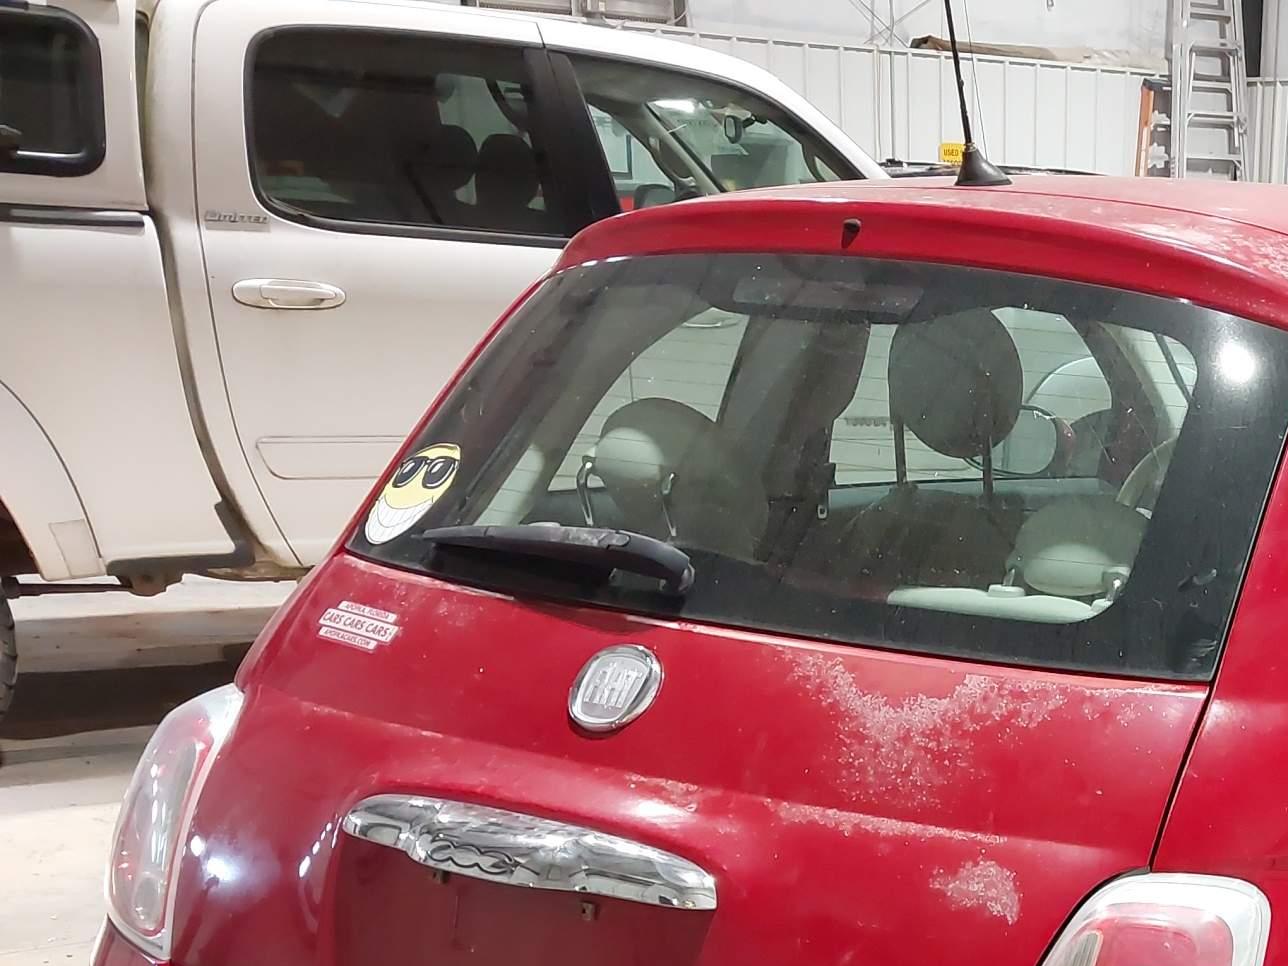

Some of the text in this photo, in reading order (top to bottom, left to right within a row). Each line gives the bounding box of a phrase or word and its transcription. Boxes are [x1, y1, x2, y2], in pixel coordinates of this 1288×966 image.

[943, 148, 959, 157] USED
[322, 610, 345, 626] CARS
[343, 616, 367, 631] CARS
[365, 622, 390, 638] CARS
[583, 661, 643, 709] FIAT
